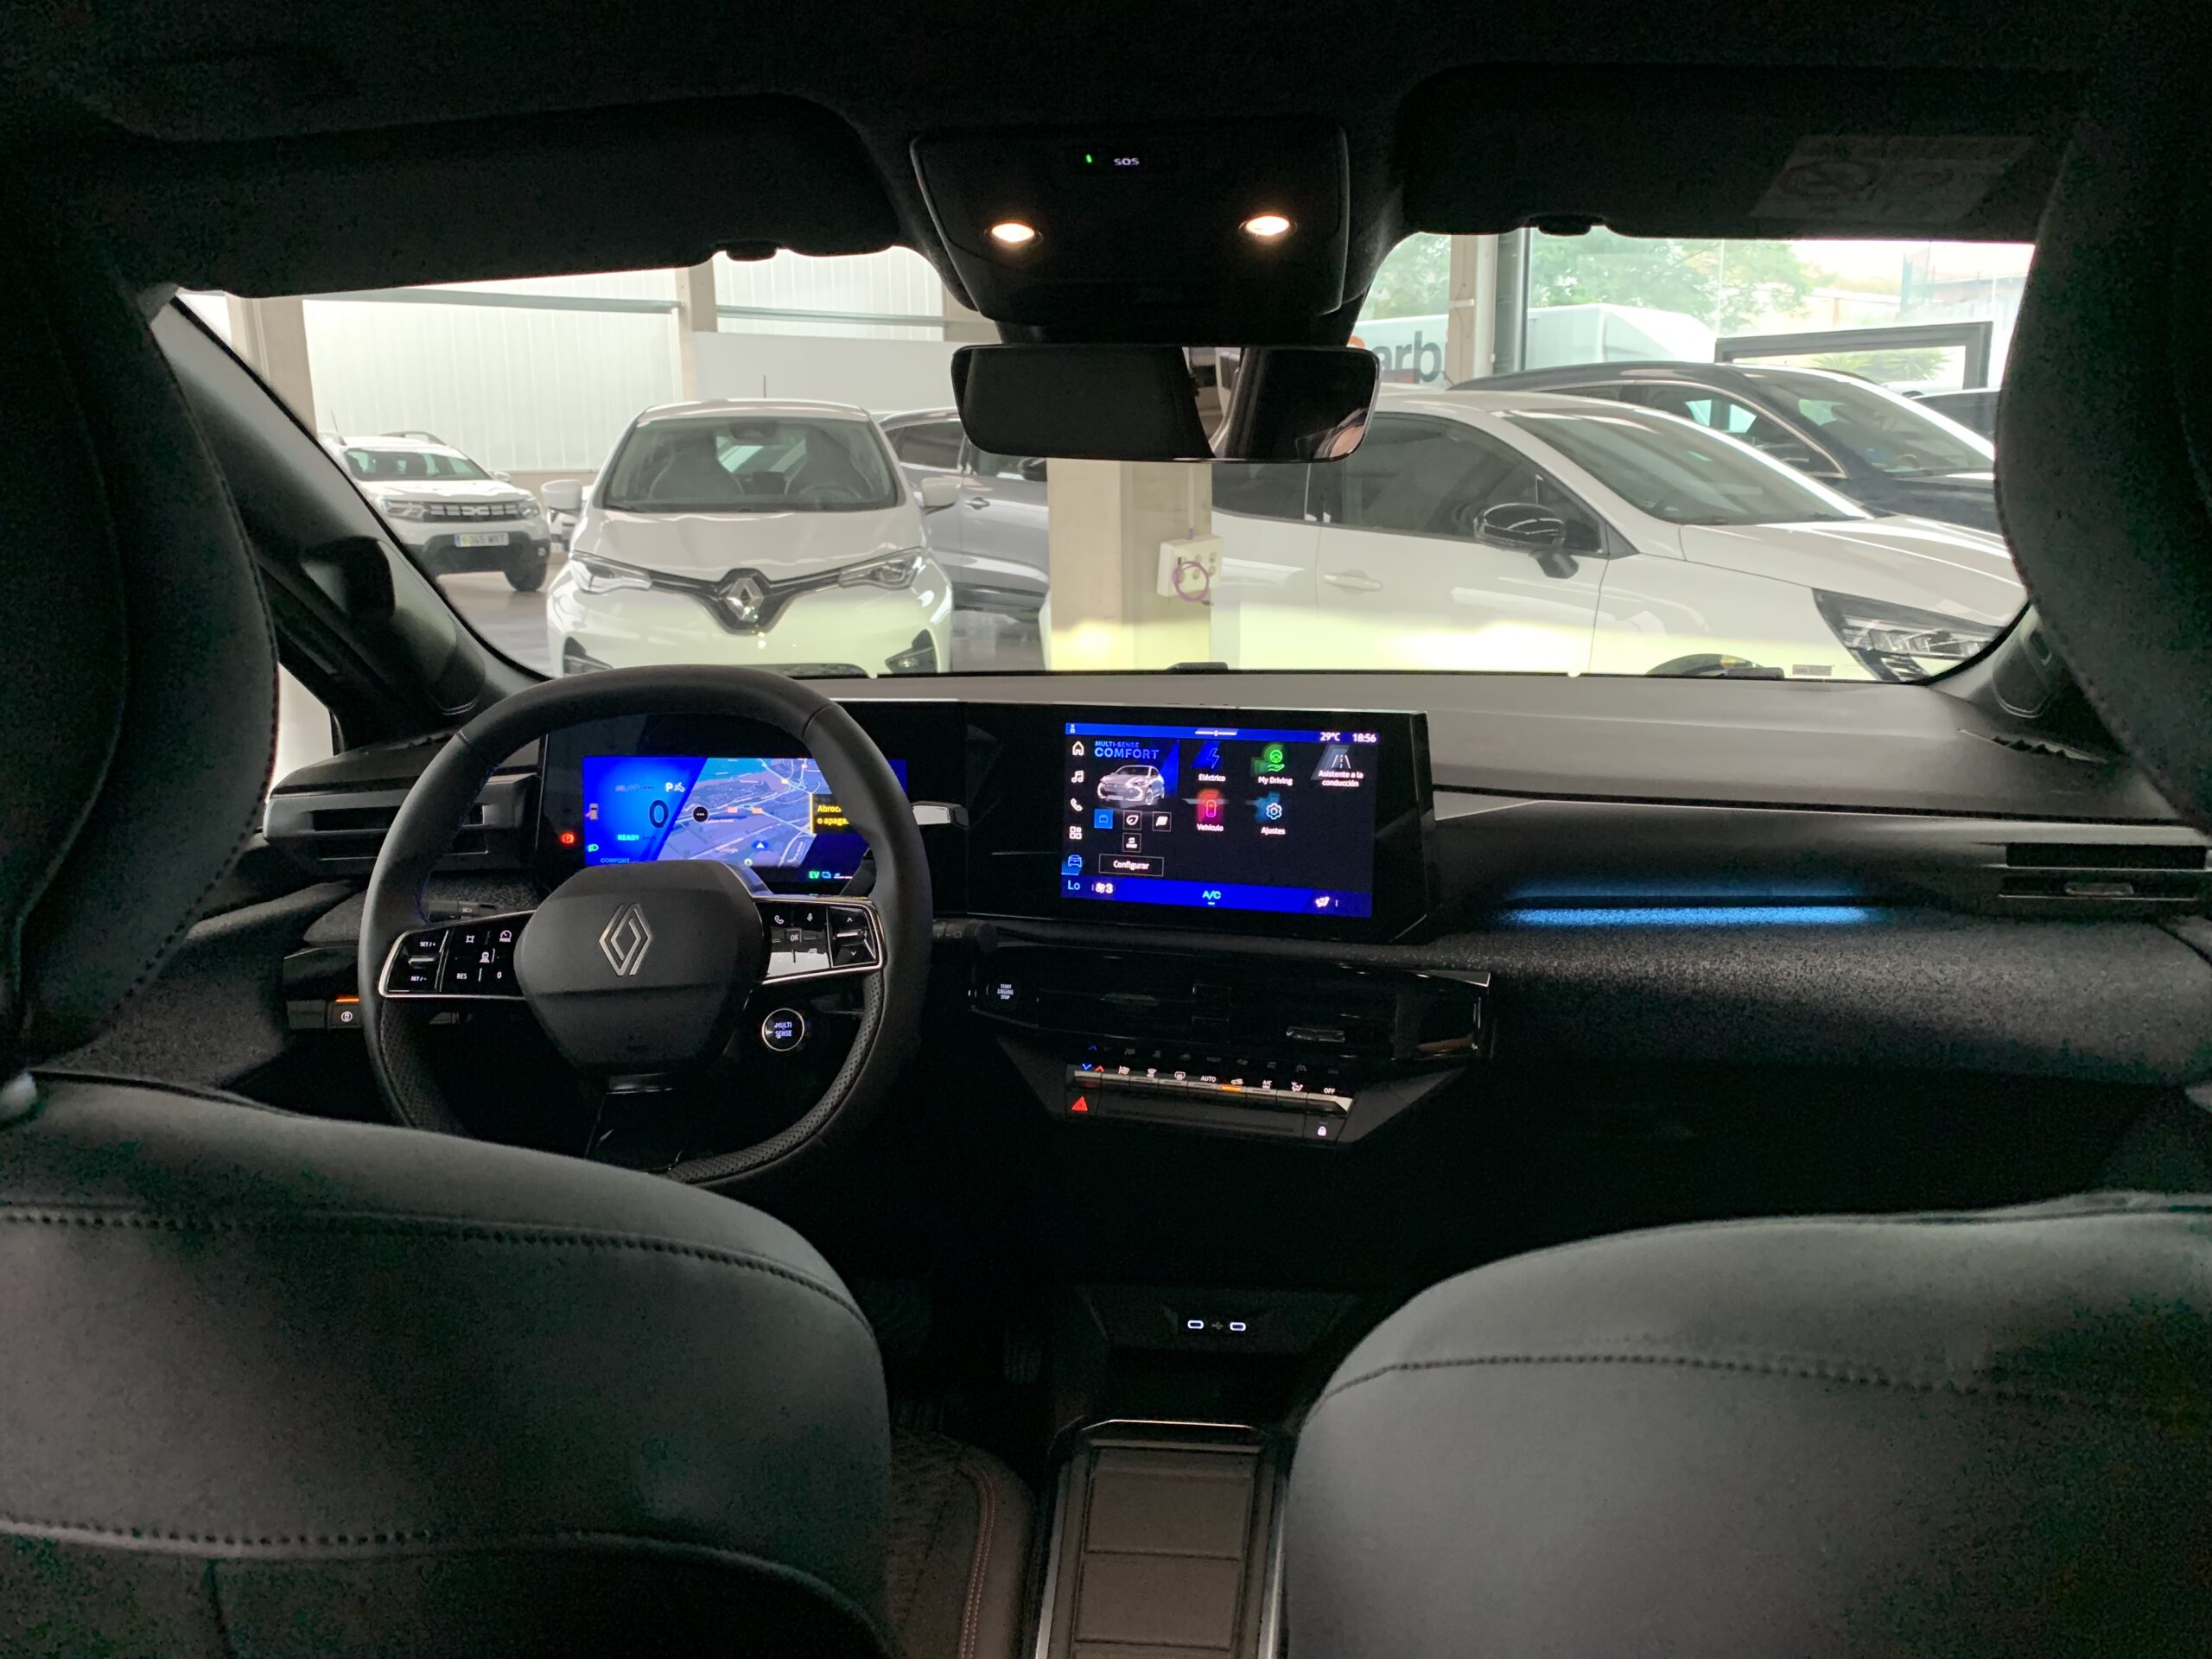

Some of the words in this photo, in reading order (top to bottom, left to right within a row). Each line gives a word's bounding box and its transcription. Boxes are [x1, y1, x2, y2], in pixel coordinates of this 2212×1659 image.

[1113, 157, 1141, 166] SOS
[1352, 733, 1377, 743] 18:56
[1094, 747, 1160, 760] COMFORT
[1198, 773, 1226, 782] Eléctrico
[1318, 770, 1350, 779] Asistente
[1258, 776, 1268, 785] My
[1269, 776, 1294, 786] Driving
[1321, 779, 1360, 787] conducción
[664, 782, 674, 792] P
[817, 804, 842, 813] Abroc
[649, 799, 669, 829] 0
[823, 817, 849, 826] apaga
[1196, 823, 1224, 832] Vehículo
[1261, 827, 1286, 836] Ajustes
[1113, 860, 1150, 871] Configurar
[1067, 880, 1081, 891] Lo
[1202, 890, 1222, 900] A/C
